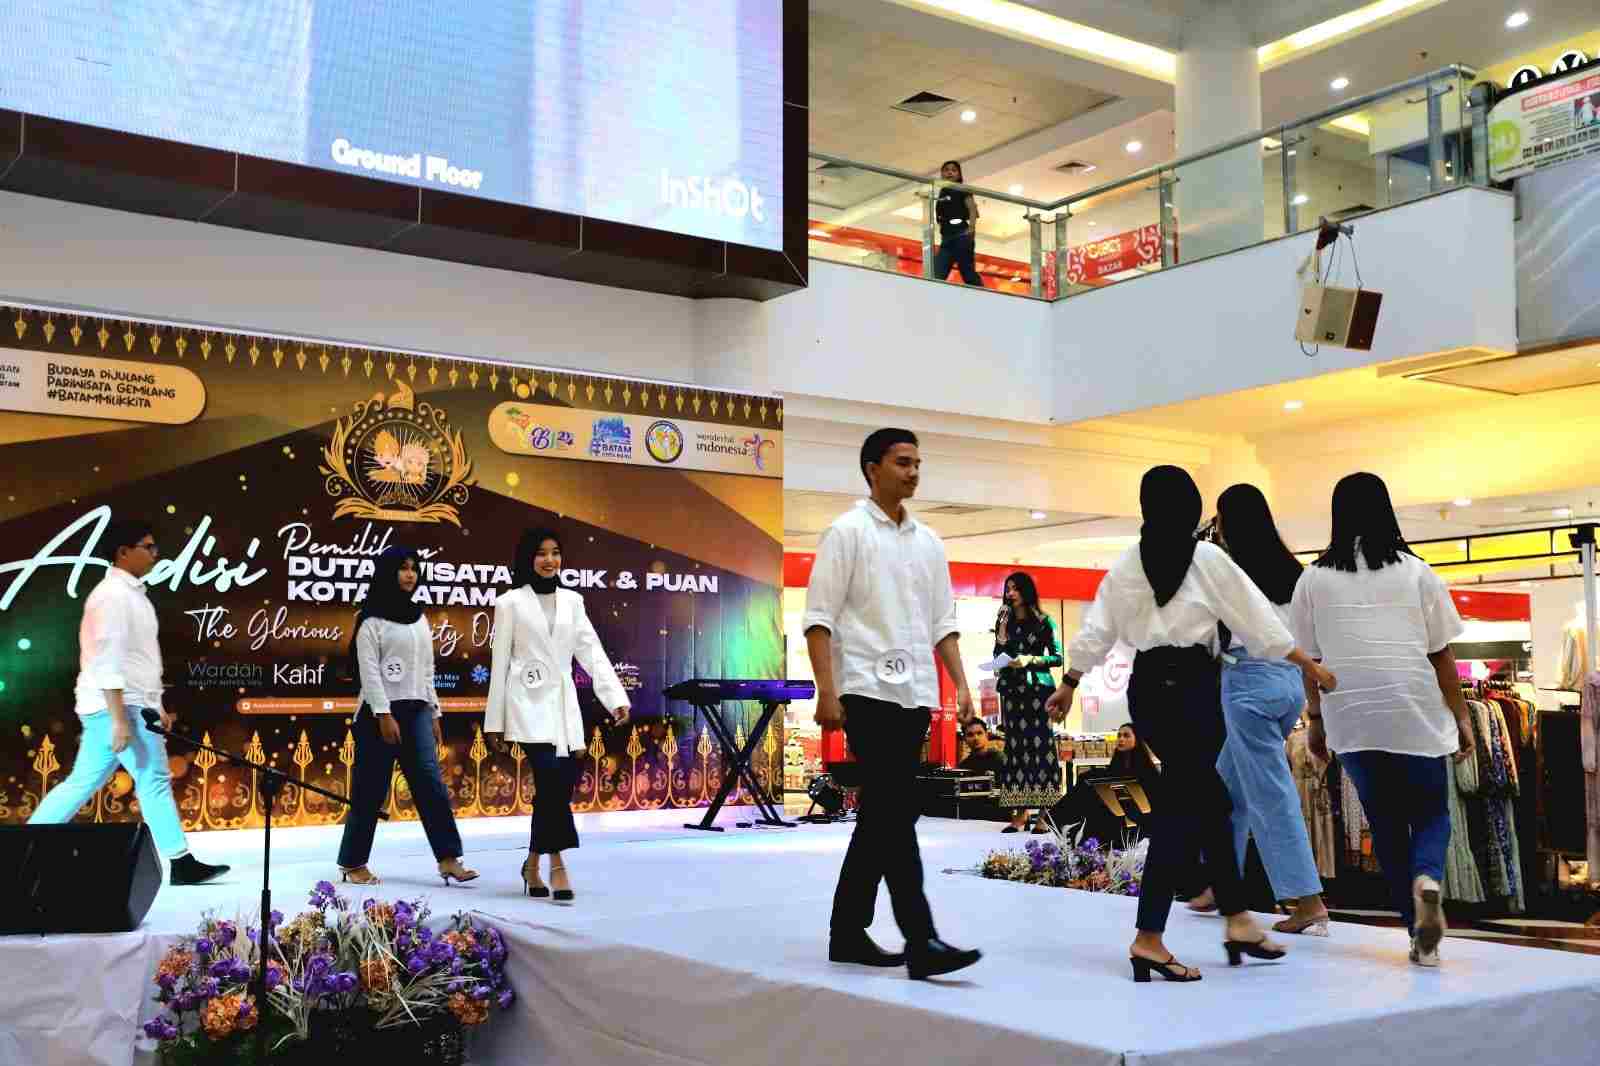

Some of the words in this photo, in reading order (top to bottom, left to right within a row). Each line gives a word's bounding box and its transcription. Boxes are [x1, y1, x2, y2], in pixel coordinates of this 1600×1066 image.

[331, 138, 421, 178] Ground
[426, 156, 482, 190] Floor
[48, 363, 95, 378] BUDAYA
[48, 376, 112, 391] PARIWISATA
[117, 384, 176, 399] GEMILANG
[696, 442, 747, 456] indonesia
[278, 521, 440, 560] Pemilihn
[0, 504, 268, 610] Adisi
[288, 556, 376, 578] DUTA
[560, 569, 608, 589] CIK
[616, 571, 638, 590] &
[646, 573, 718, 593] PUAN
[410, 585, 496, 606] ATAM
[184, 603, 237, 643] The
[247, 606, 343, 650] Glorious
[188, 662, 263, 679] Wardah
[273, 663, 325, 685] Kahf
[387, 663, 402, 676] 53
[527, 669, 542, 683] 51
[885, 657, 905, 676] 50
